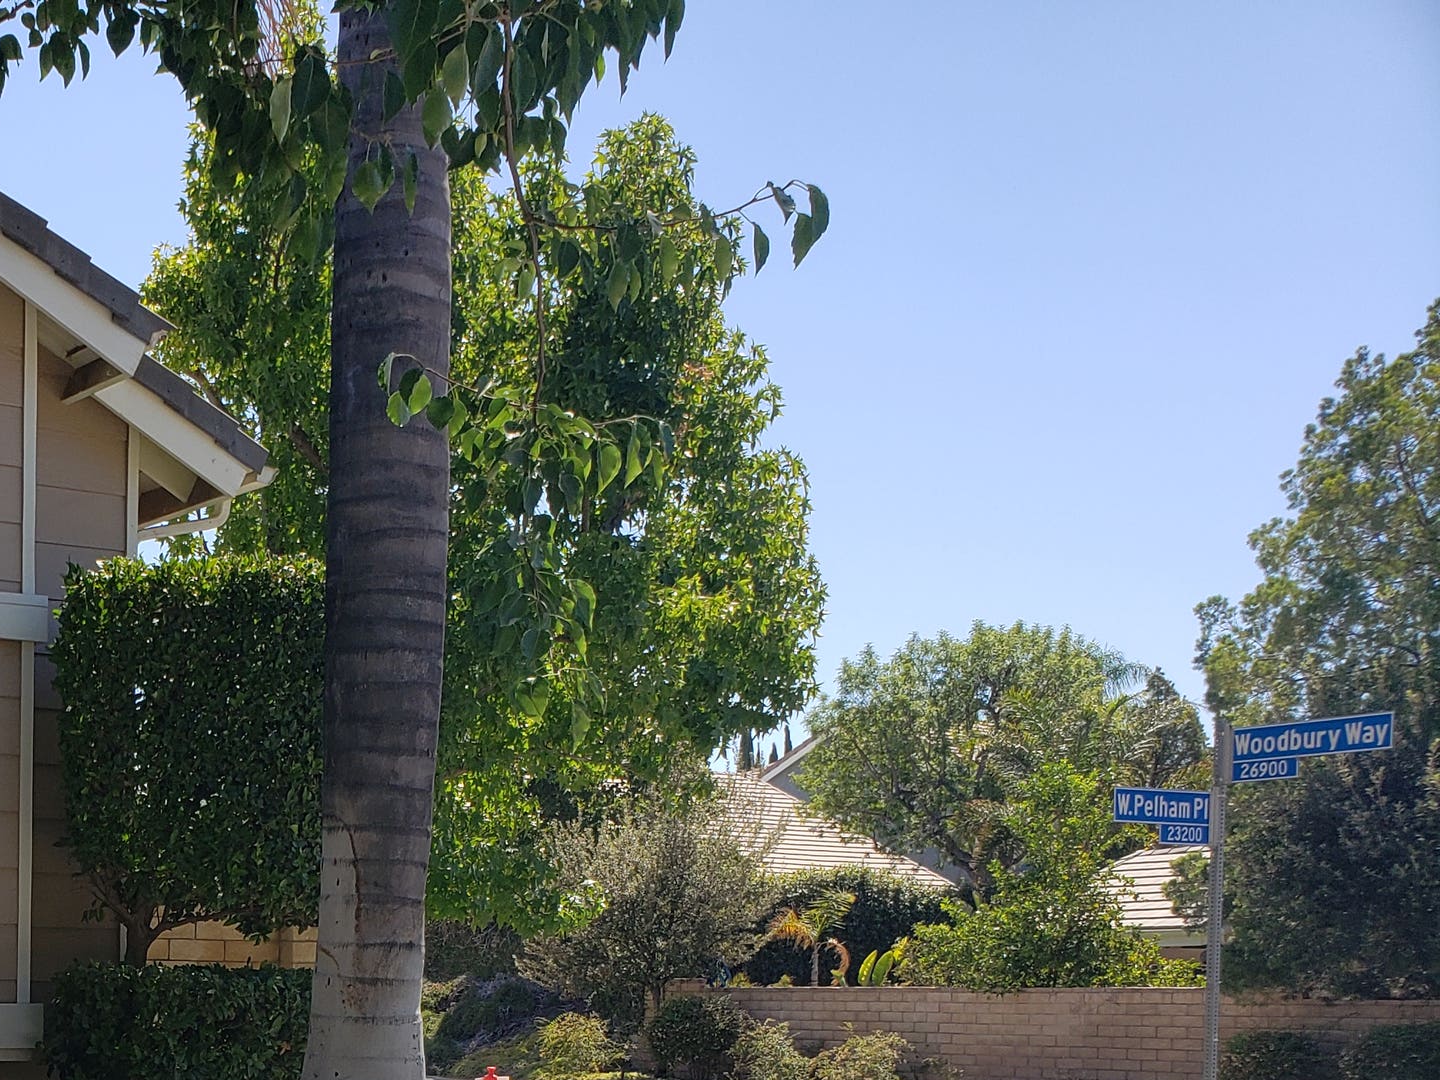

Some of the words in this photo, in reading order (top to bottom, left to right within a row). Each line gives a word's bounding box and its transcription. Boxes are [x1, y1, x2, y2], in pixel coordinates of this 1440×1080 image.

[1235, 728, 1341, 756] Woodbury
[1345, 721, 1389, 746] Way
[1240, 760, 1287, 778] 26900
[1193, 797, 1209, 819] Pl
[1167, 826, 1202, 842] 23200
